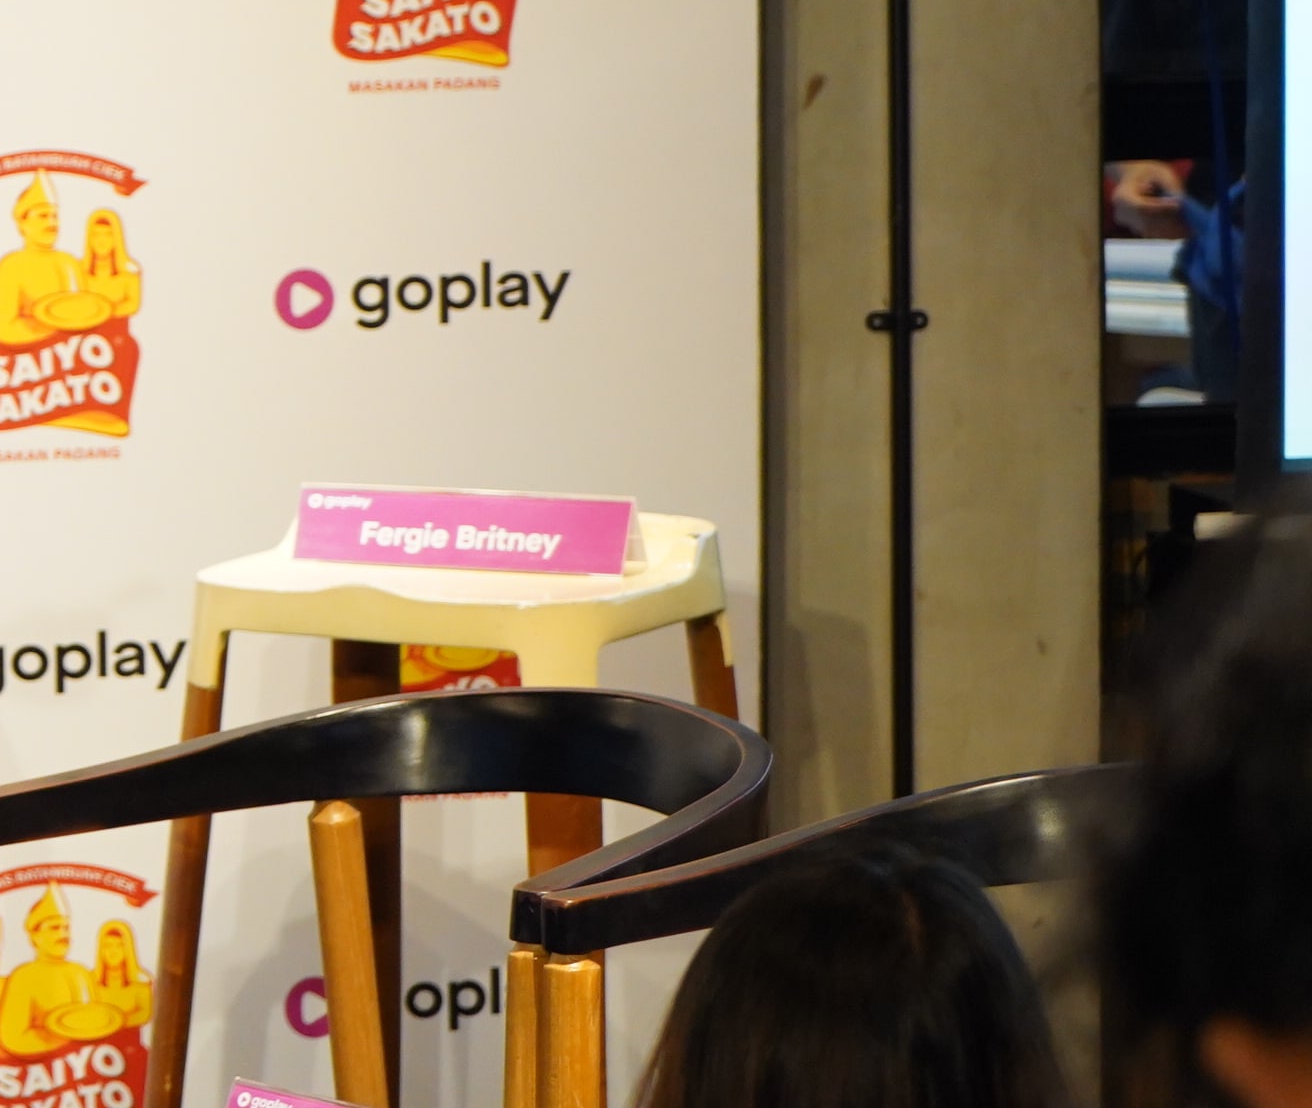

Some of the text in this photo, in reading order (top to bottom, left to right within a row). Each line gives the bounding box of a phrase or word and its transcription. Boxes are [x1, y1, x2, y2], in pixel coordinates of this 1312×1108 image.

[348, 0, 501, 53] SAKATO
[349, 76, 500, 92] MASAKAN PADANG
[352, 261, 571, 329] goplay
[54, 445, 121, 459] PADANG
[323, 494, 372, 510] goplay
[360, 521, 562, 559] Fergie Britney
[404, 967, 501, 1031] opl
